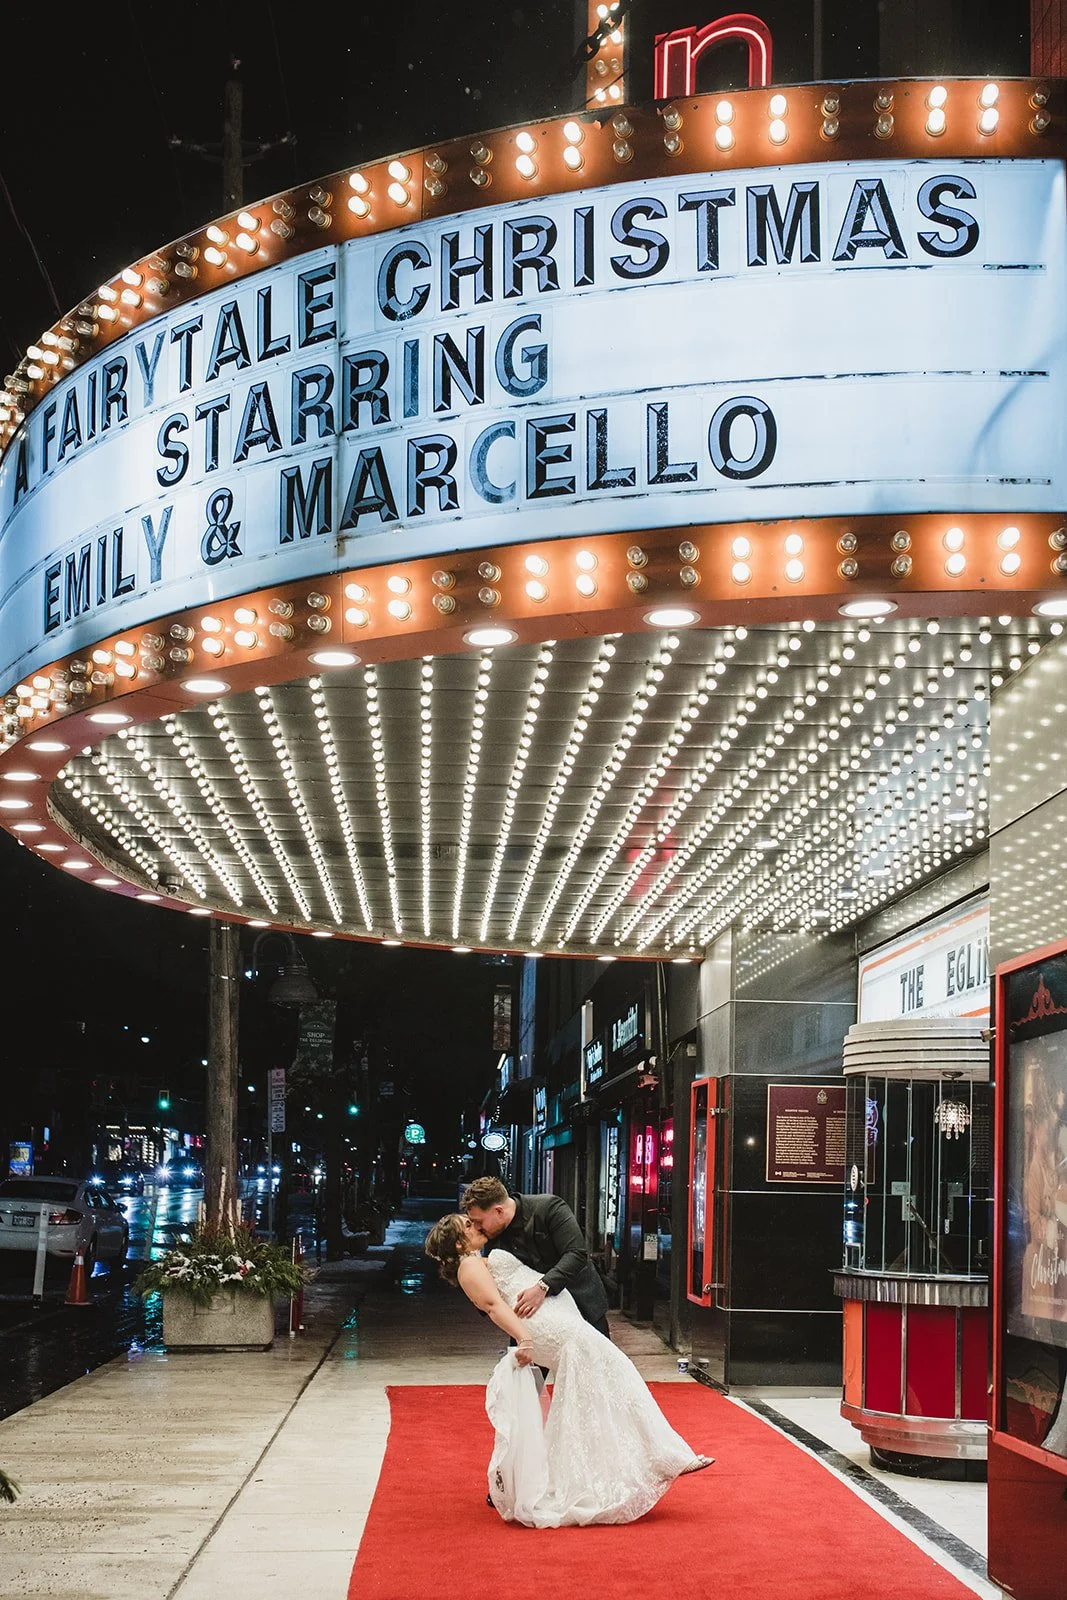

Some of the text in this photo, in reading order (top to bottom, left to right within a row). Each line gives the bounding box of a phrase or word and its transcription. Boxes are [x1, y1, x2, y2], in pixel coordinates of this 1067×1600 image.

[13, 174, 980, 507] A FAIRYTALE CHRISTMAS
[155, 313, 549, 488] STARRING
[44, 395, 777, 635] EMILY & MARCELLO
[900, 964, 925, 1014] THE
